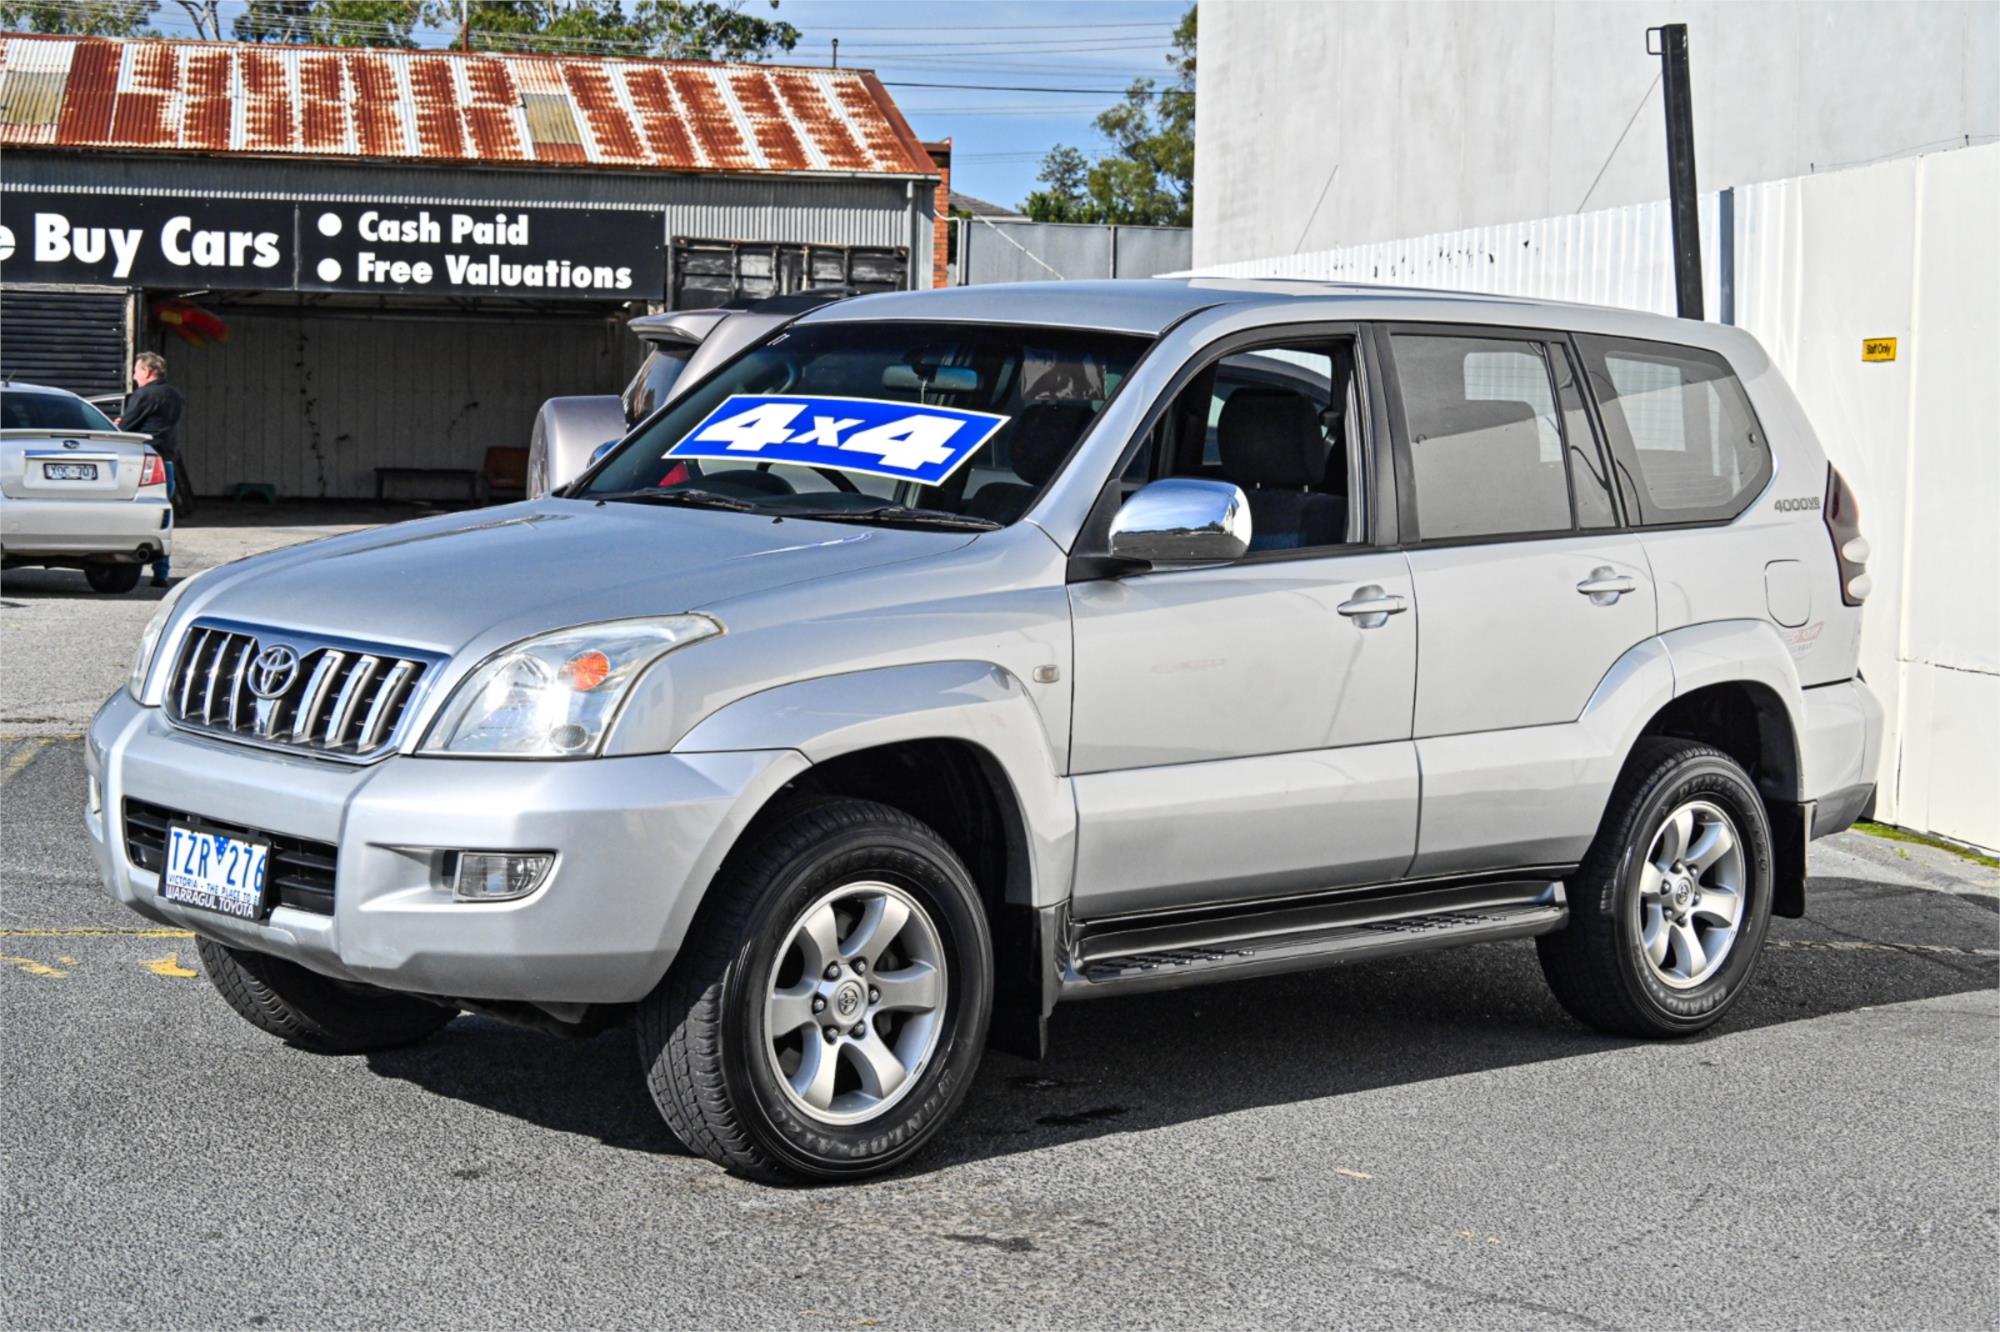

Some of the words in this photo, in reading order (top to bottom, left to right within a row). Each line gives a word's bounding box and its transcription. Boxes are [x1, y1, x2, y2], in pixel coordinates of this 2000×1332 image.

[34, 213, 143, 278] Buy
[161, 216, 280, 268] Cars
[358, 211, 441, 243] Cash
[452, 213, 529, 245] Paid
[358, 252, 433, 284] Free
[445, 254, 632, 289] Valuations
[693, 403, 967, 470] 4x4
[1775, 497, 1808, 512] 4000
[173, 832, 210, 878] TZR
[227, 845, 266, 892] 276
[166, 885, 217, 909] WARRAGUL
[219, 896, 254, 918] TOYOTA
[169, 874, 198, 889] VICTORIA
[207, 882, 219, 895] THE
[222, 886, 240, 901] PLACE
[244, 891, 252, 904] TO
